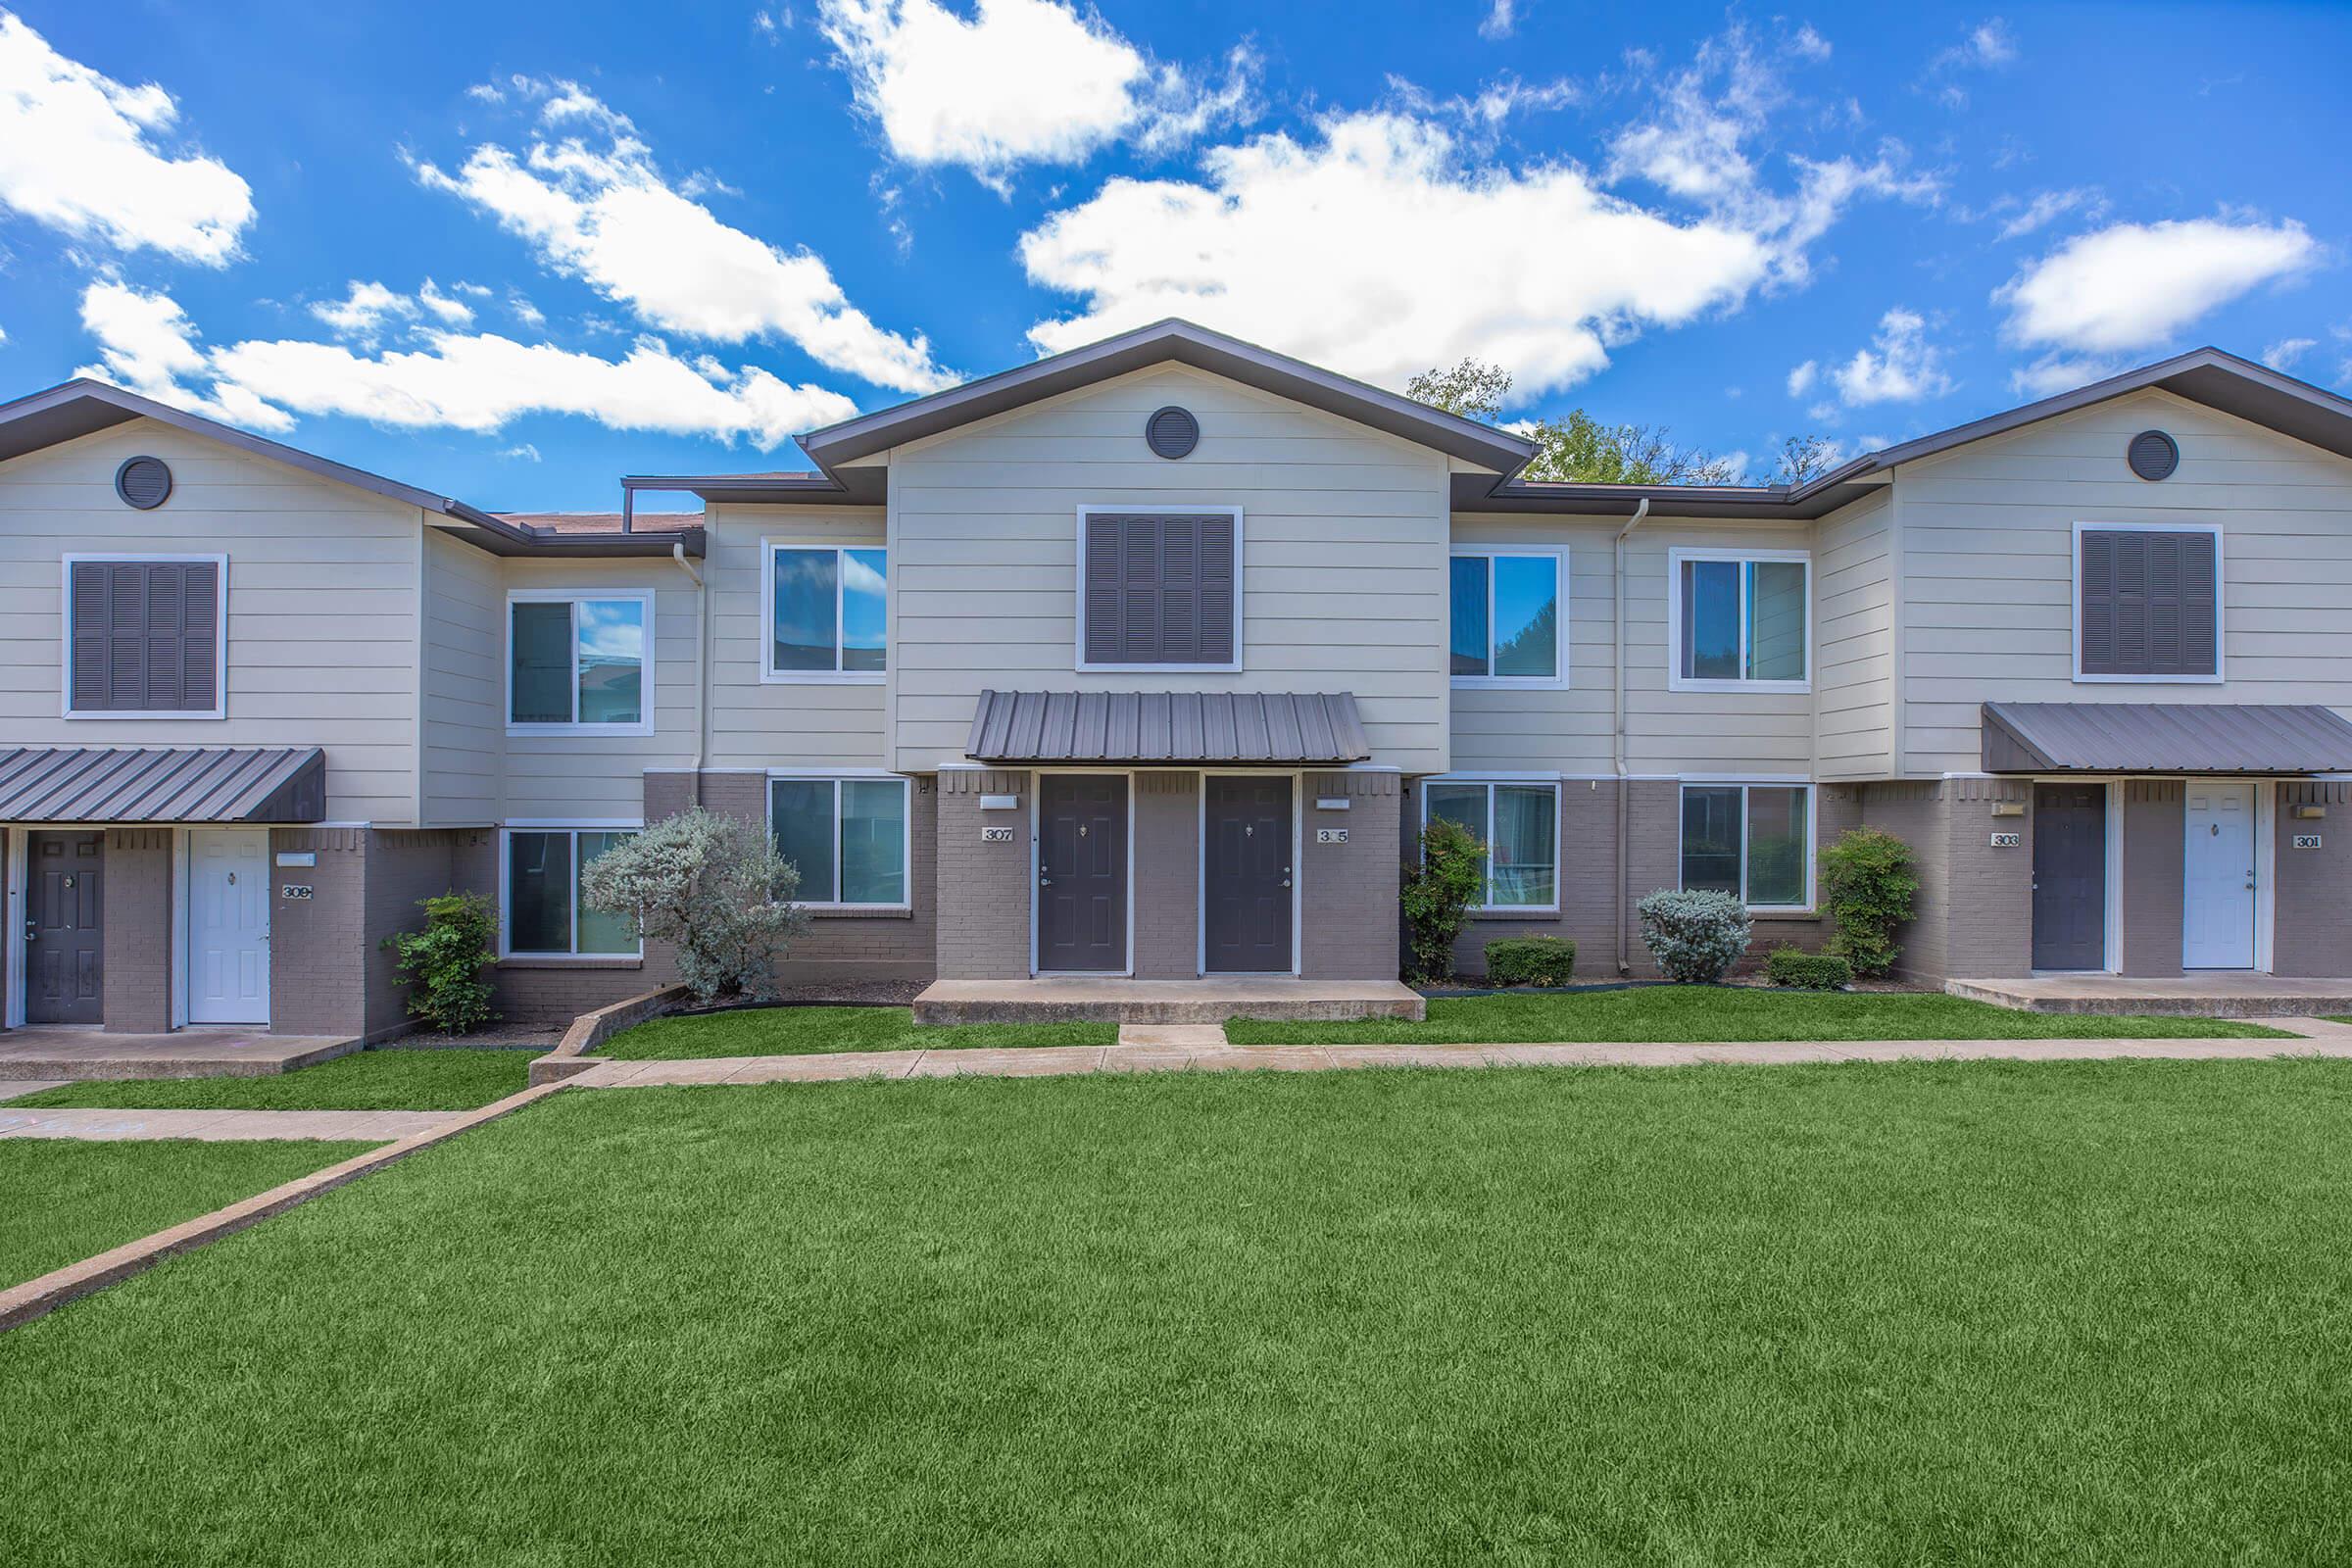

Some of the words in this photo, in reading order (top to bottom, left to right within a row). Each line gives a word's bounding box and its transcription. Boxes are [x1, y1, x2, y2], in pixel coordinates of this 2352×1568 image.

[986, 829, 1012, 840] 307
[1320, 830, 1348, 842] 35
[1995, 835, 2019, 846] 303
[2297, 837, 2320, 848] 301
